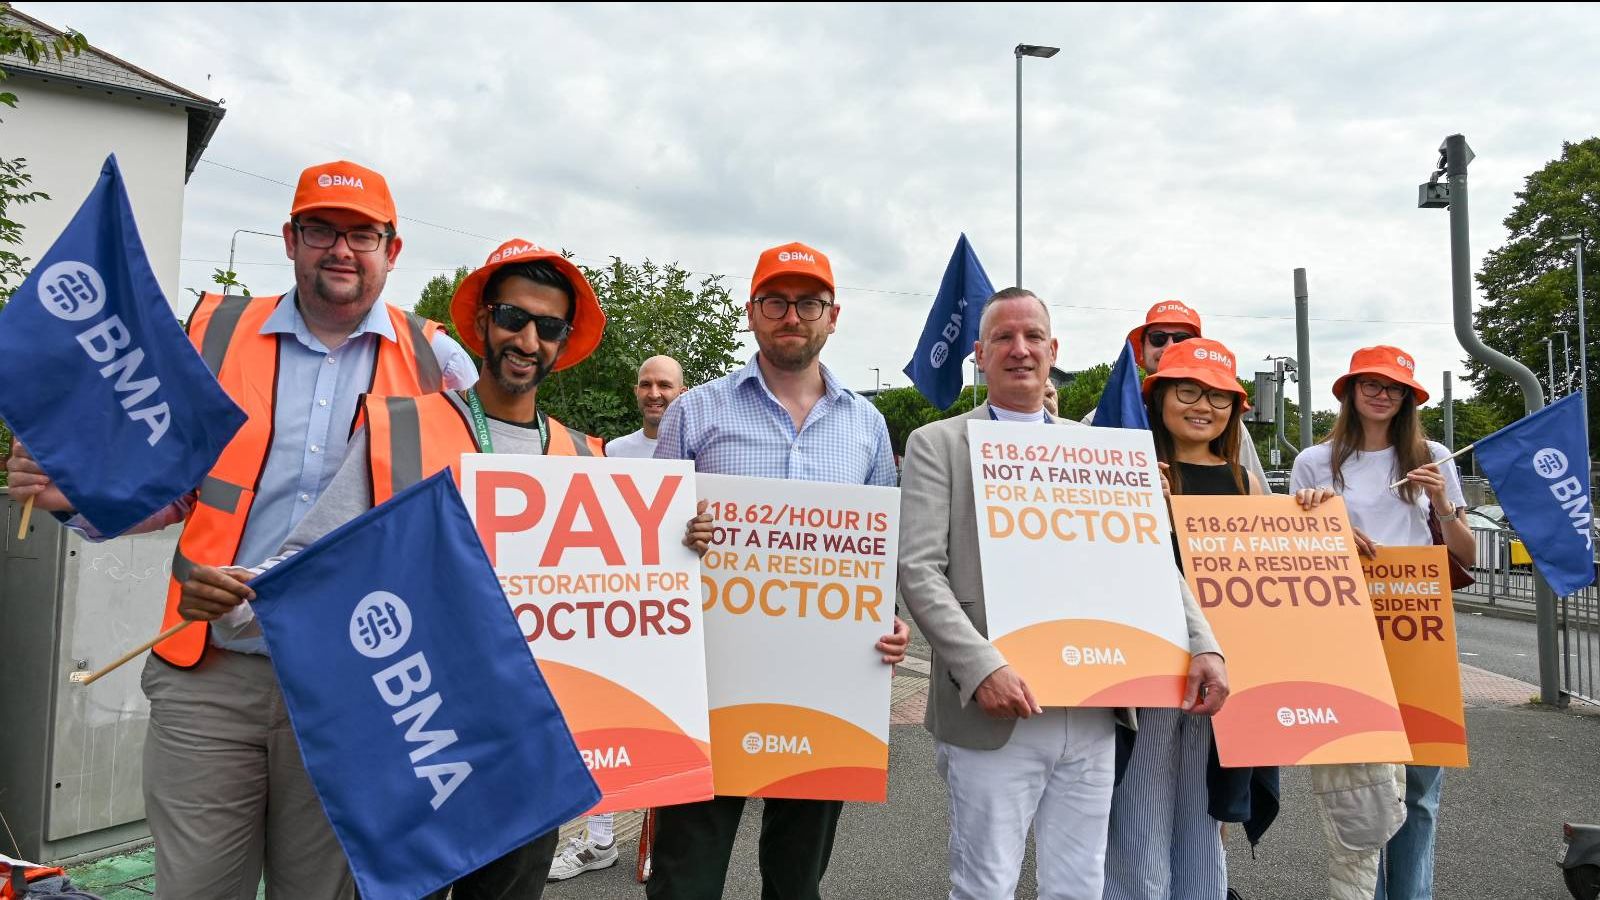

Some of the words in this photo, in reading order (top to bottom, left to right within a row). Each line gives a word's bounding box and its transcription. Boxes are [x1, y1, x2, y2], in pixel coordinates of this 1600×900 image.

[333, 175, 364, 190] BMA
[503, 244, 540, 259] BMA
[791, 251, 816, 264] BMA
[1209, 350, 1232, 369] BMA
[75, 314, 171, 447] BMA
[475, 414, 489, 446] DOCTOR
[980, 442, 1123, 466] £18.62/HOUR
[1128, 451, 1148, 468] IS
[983, 464, 1024, 481] NOT
[1030, 466, 1044, 482] A
[1048, 466, 1092, 485] FAIR
[1095, 470, 1152, 487] WAGE
[985, 484, 1027, 502] FOR
[1033, 487, 1048, 503] A
[1052, 487, 1153, 507] RESIDENT
[475, 470, 683, 568] PAY
[711, 501, 860, 530] 18.62/HOUR
[866, 512, 888, 532] IS
[987, 505, 1160, 544] DOCTOR
[1185, 515, 1320, 533] £18.62/HOUR
[1324, 516, 1342, 533] IS
[712, 526, 742, 546] OT
[745, 529, 761, 548] A
[768, 530, 818, 552] FAIR
[823, 533, 886, 556] WAGE
[1188, 537, 1227, 553] NOT
[1232, 536, 1247, 553] A
[1250, 536, 1290, 552] FAIR
[1293, 536, 1348, 552] WAGE
[704, 549, 739, 571] OR
[744, 553, 761, 572] A
[768, 554, 886, 580] RESIDENT
[1192, 557, 1233, 572] FOR
[1238, 557, 1252, 572] A
[1255, 556, 1350, 572] RESIDENT
[1422, 564, 1439, 578] IS
[498, 573, 641, 596] STORATION
[647, 572, 690, 593] FOR
[1196, 576, 1361, 608] DOCTOR
[1390, 581, 1441, 595] WAGE
[1371, 599, 1442, 612] SIDENT
[513, 598, 692, 643] OCTORS
[1375, 615, 1445, 642] TOR
[1084, 647, 1126, 666] BMA
[1296, 708, 1338, 725] BMA
[372, 651, 473, 811] BMA
[766, 735, 812, 755] BMA
[580, 746, 631, 770] BMA
